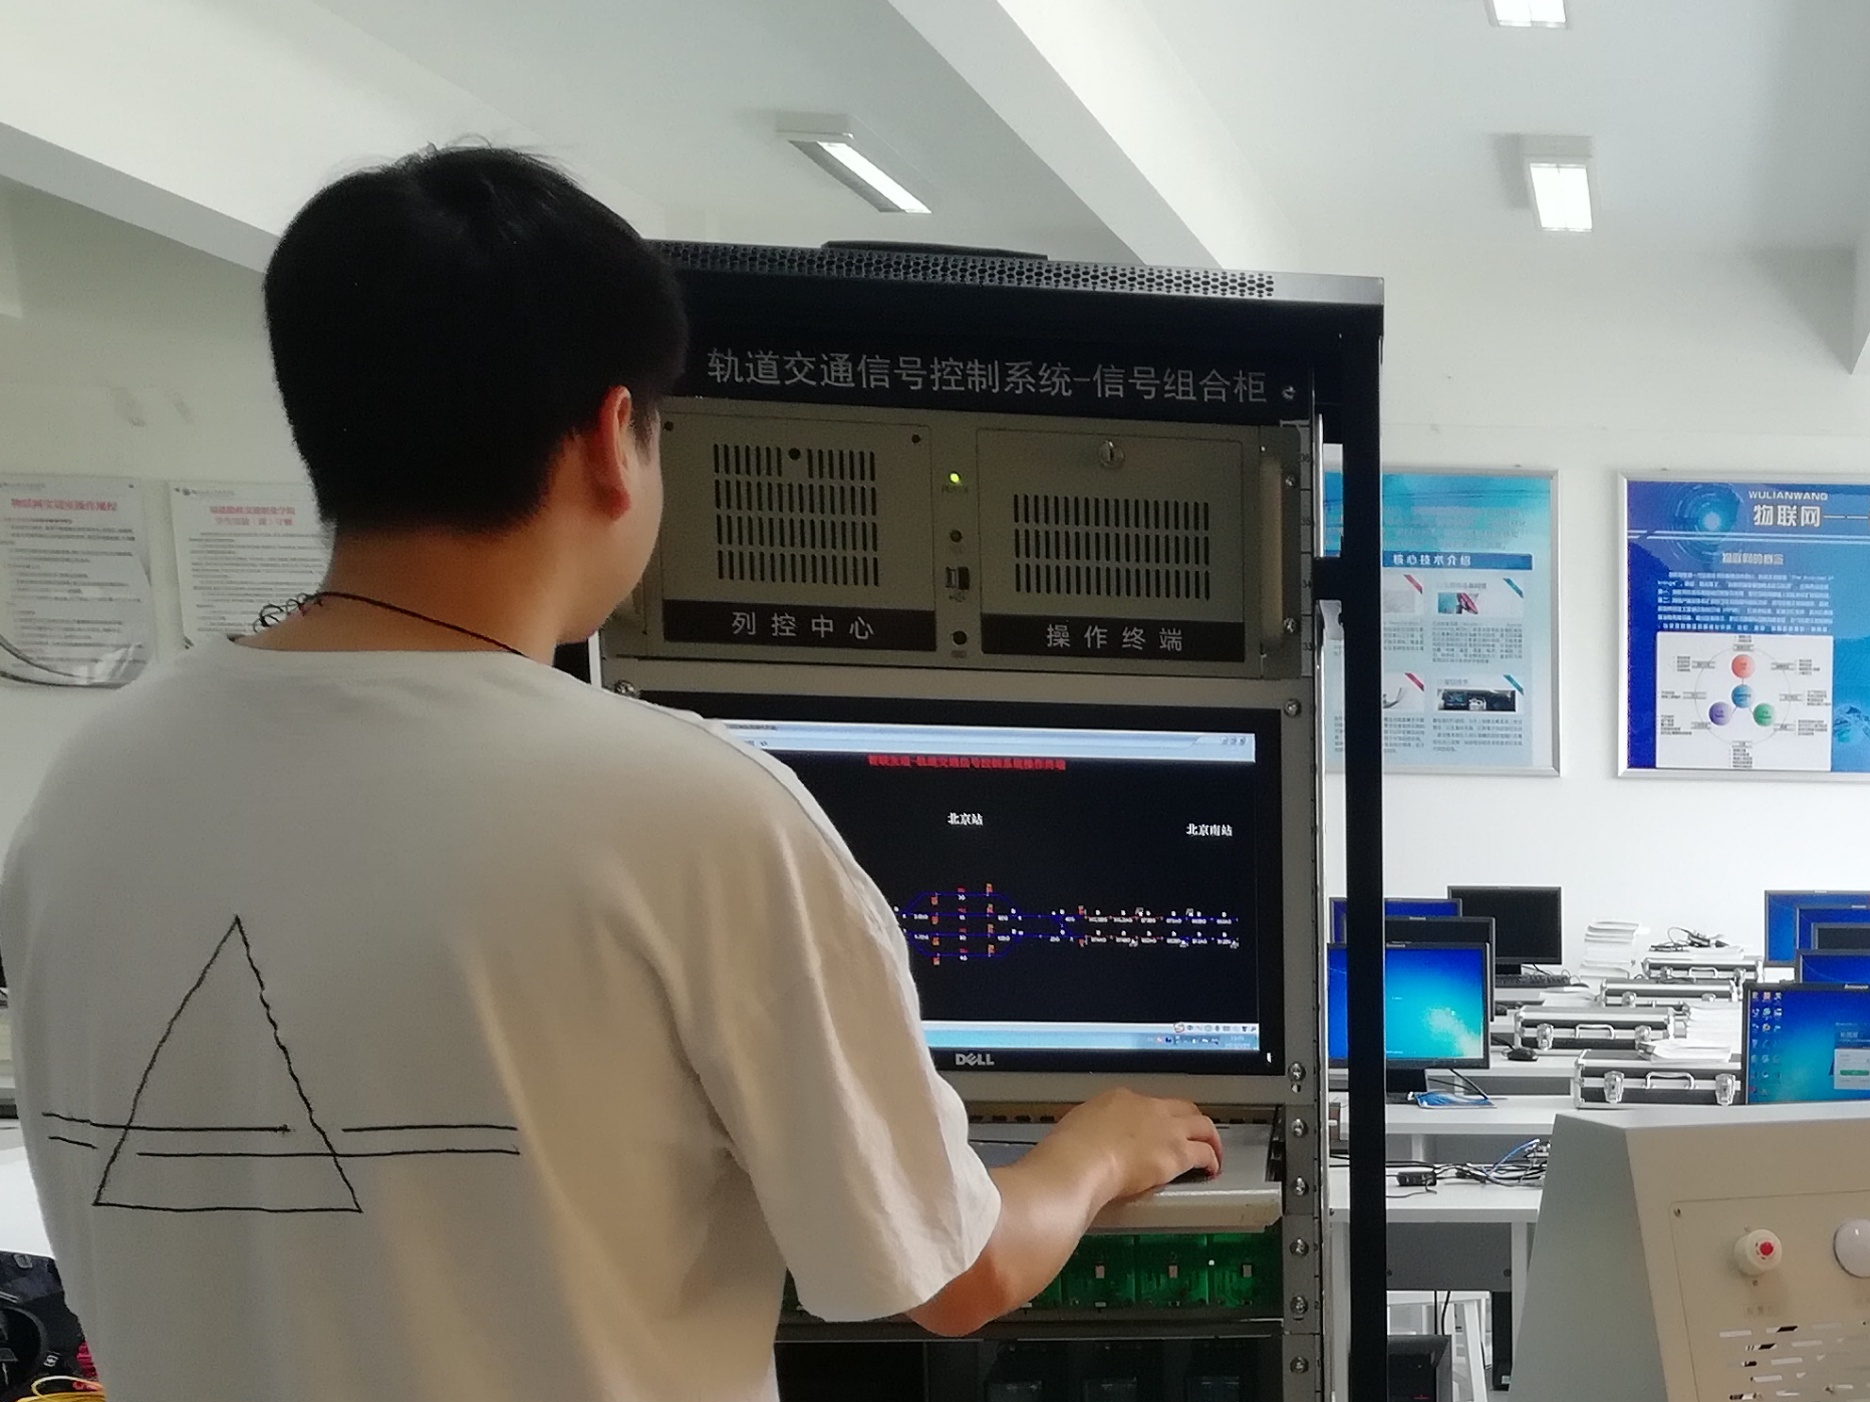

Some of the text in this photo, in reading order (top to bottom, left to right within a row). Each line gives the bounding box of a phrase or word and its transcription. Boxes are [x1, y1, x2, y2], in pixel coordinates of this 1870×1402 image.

[706, 347, 1267, 404] 轨道交通信号控制系统-信号组合柜
[1748, 490, 1829, 501] WULIANWANG
[731, 610, 875, 642] 列控中心
[1045, 624, 1184, 653] 操作终端
[947, 812, 984, 826] 北京站
[1186, 823, 1234, 837] 北京南站
[955, 1053, 995, 1066] DELL
